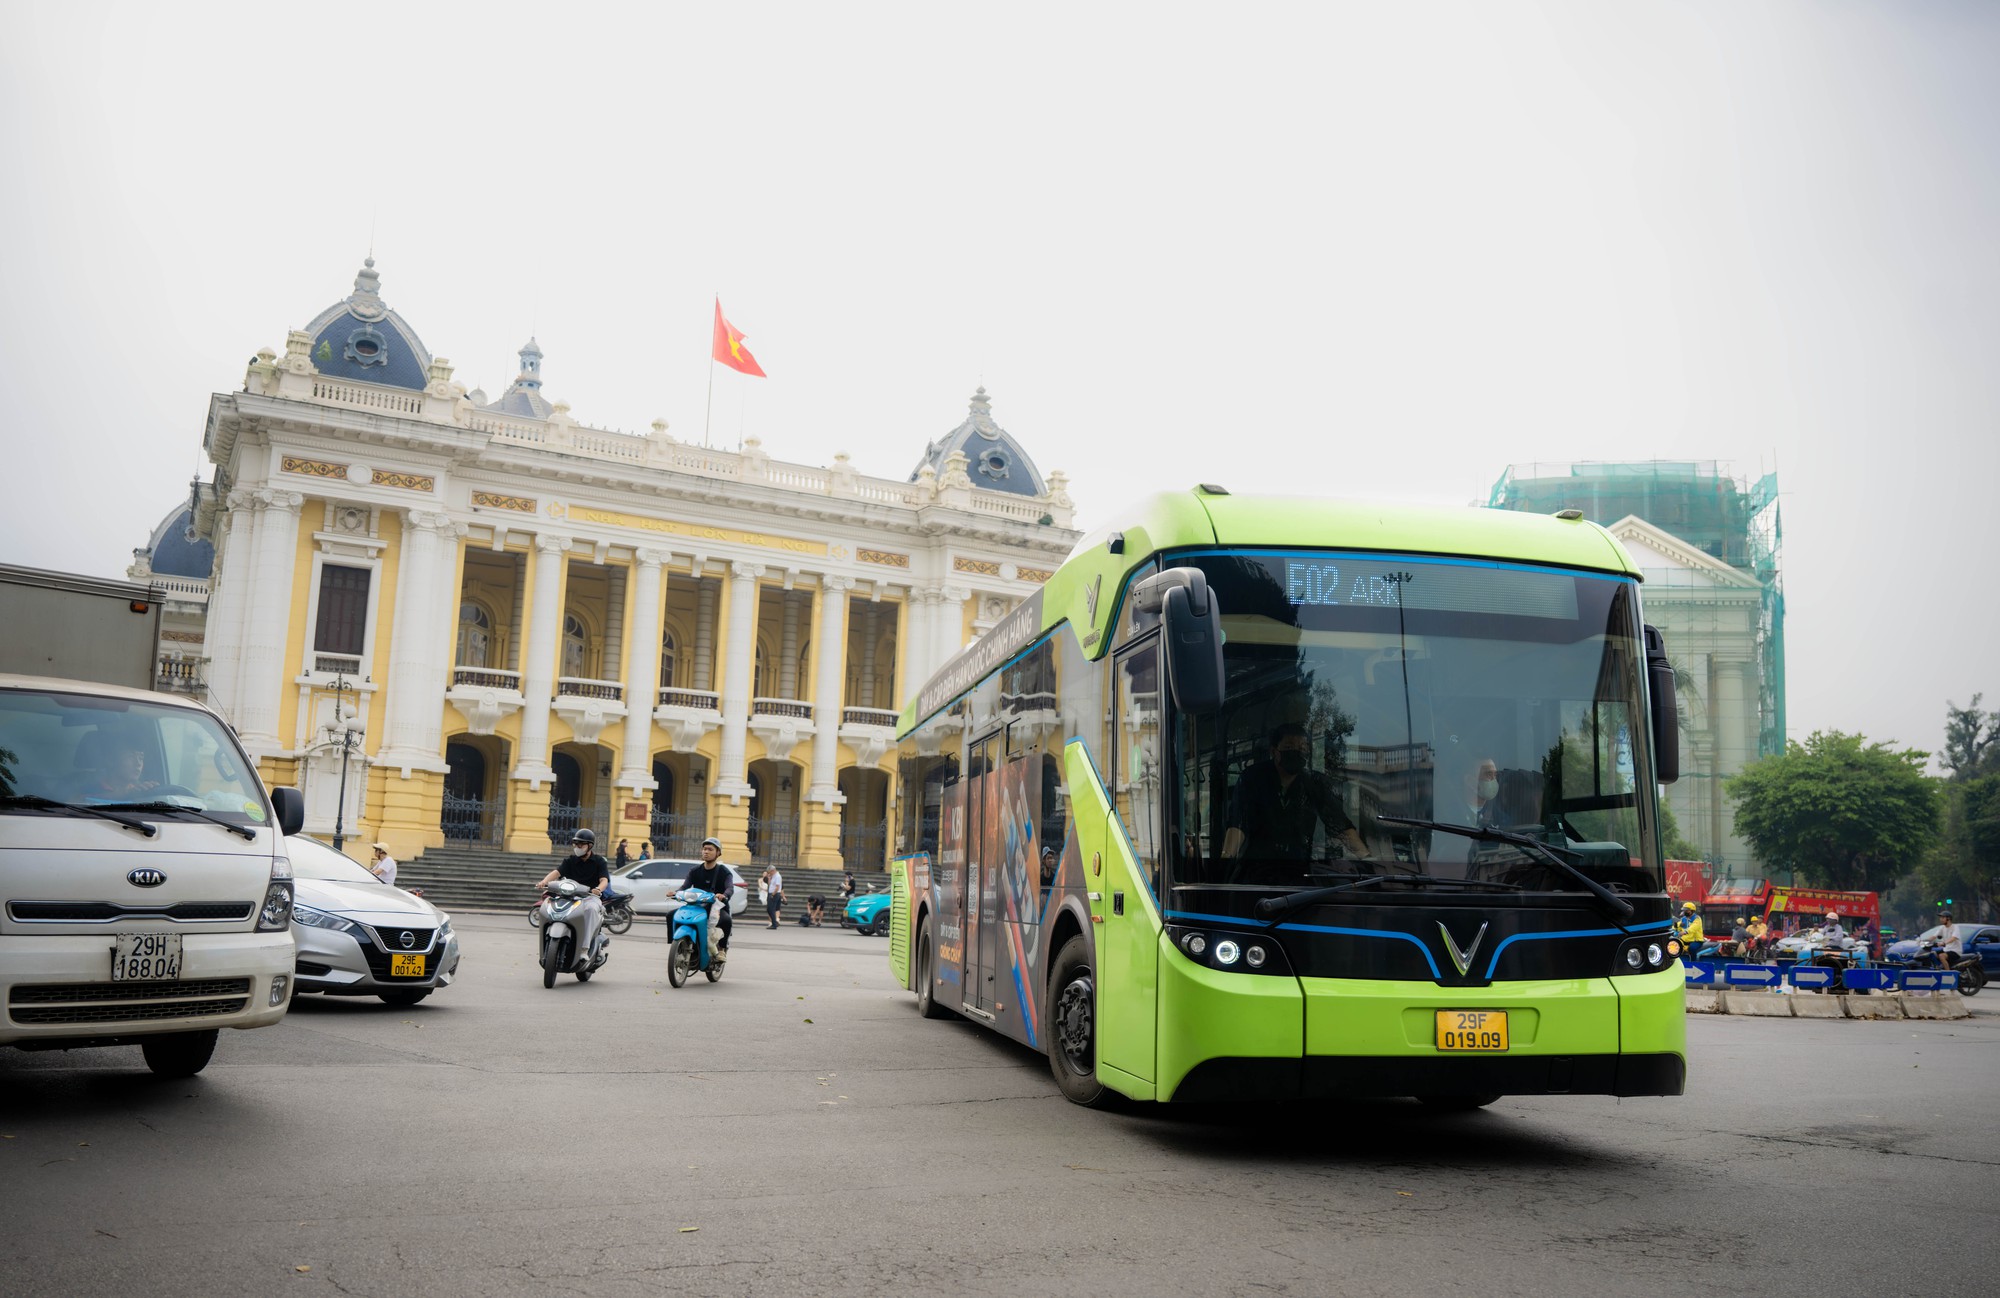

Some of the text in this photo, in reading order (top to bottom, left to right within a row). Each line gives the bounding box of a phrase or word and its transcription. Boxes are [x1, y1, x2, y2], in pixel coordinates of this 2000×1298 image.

[1289, 563, 1400, 605] E02 ARK
[135, 871, 161, 883] KIA
[132, 936, 166, 956] 29H
[402, 955, 417, 965] 29E
[395, 966, 422, 975] 001.42
[1457, 1013, 1487, 1029] 29F
[1445, 1031, 1501, 1048] 019.09
